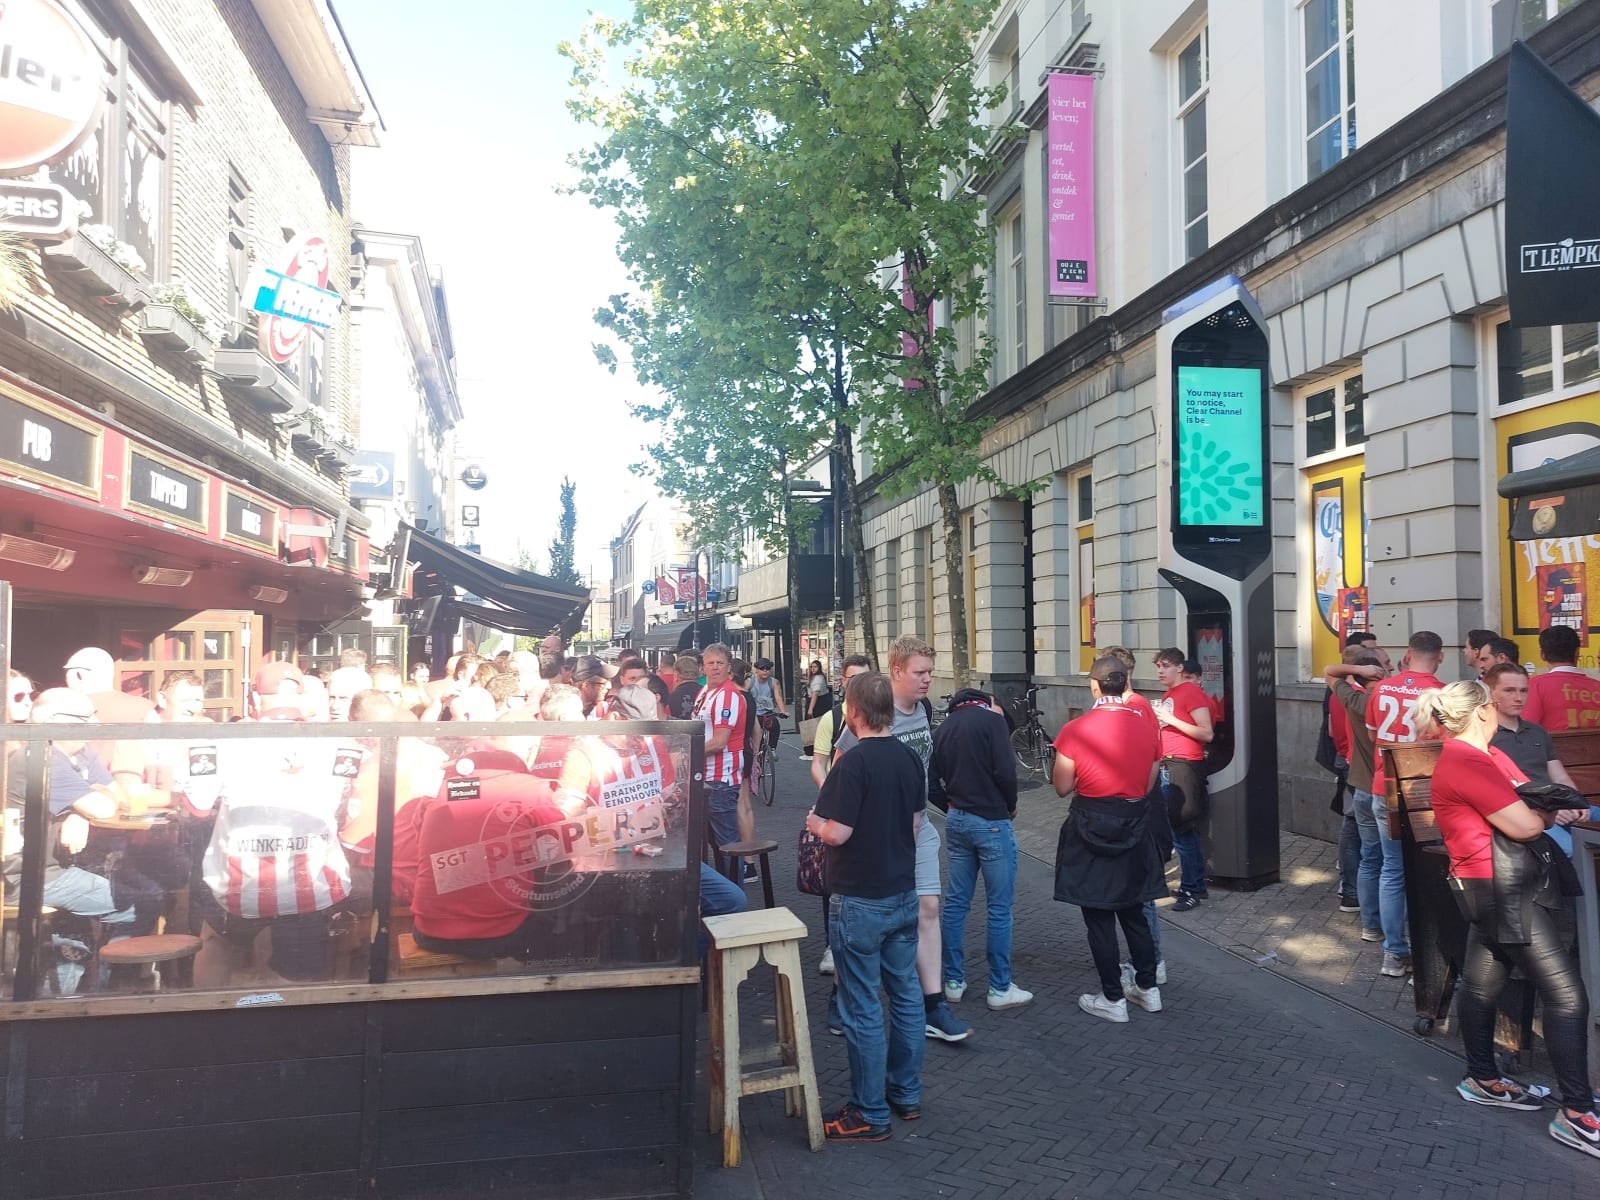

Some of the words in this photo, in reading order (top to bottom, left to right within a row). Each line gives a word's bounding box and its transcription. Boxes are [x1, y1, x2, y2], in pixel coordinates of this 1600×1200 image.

[1052, 96, 1070, 108] vier
[1072, 96, 1087, 109] het
[1052, 110, 1080, 124] leven;
[1051, 171, 1076, 182] drink,
[1051, 185, 1077, 196] ontdek
[1052, 199, 1064, 209] &
[1051, 211, 1076, 223] geniet
[1541, 245, 1600, 267] LEMPK
[1186, 388, 1202, 397] You
[1203, 390, 1221, 399] may
[1197, 399, 1226, 408] notice,
[1186, 407, 1208, 415] Clear
[1209, 408, 1242, 416] Channel
[1186, 416, 1193, 424] is
[22, 419, 53, 463] PUB
[603, 779, 659, 800] BRAINPORT
[605, 787, 662, 809] EINDHOVEN
[436, 850, 469, 871] SGT
